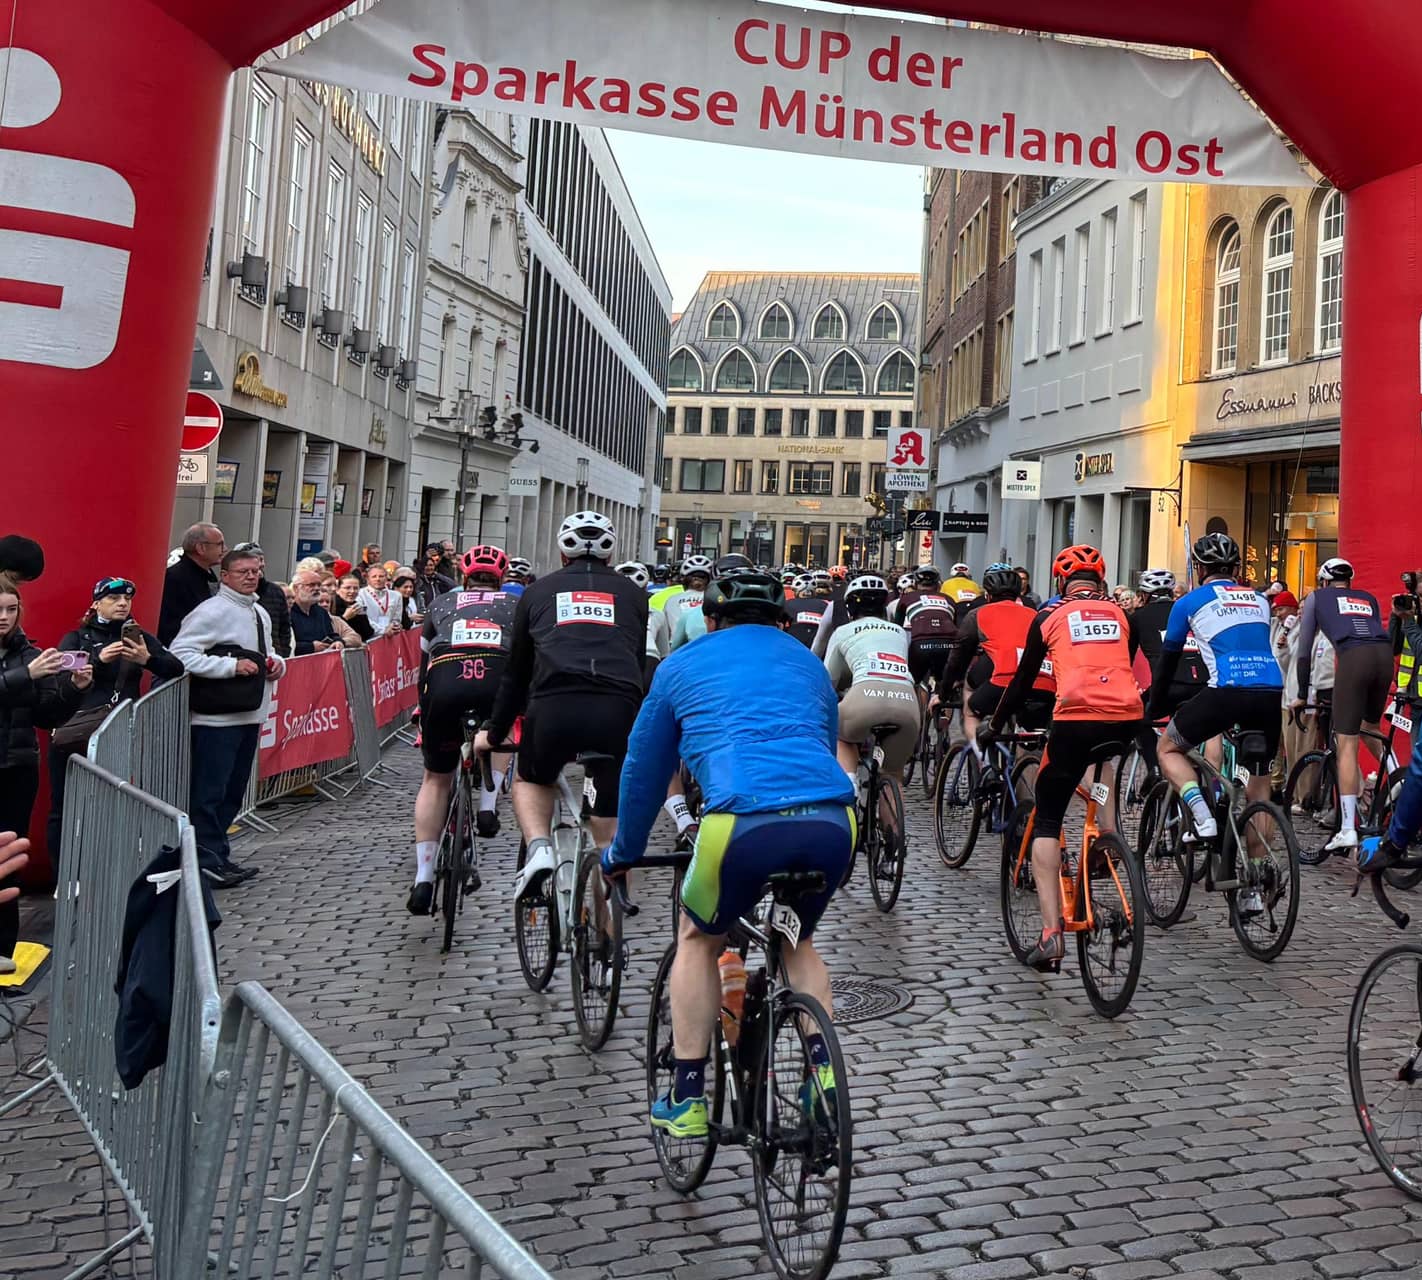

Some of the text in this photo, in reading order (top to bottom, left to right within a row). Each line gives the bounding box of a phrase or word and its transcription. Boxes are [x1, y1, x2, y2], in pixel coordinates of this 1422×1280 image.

[734, 18, 964, 89] CUP der
[407, 44, 1225, 177] Sparkasse Münsterland Ost
[1216, 388, 1298, 420] Essmanns
[178, 471, 193, 482] frei
[887, 480, 926, 488] APOTHEKE
[1229, 593, 1257, 601] 1498
[561, 606, 612, 617] B 1863
[1216, 607, 1238, 617] UKM
[466, 631, 499, 640] 1797
[1084, 624, 1118, 636] 1657
[880, 661, 907, 673] 1730
[863, 689, 914, 701] VAN RYSEL
